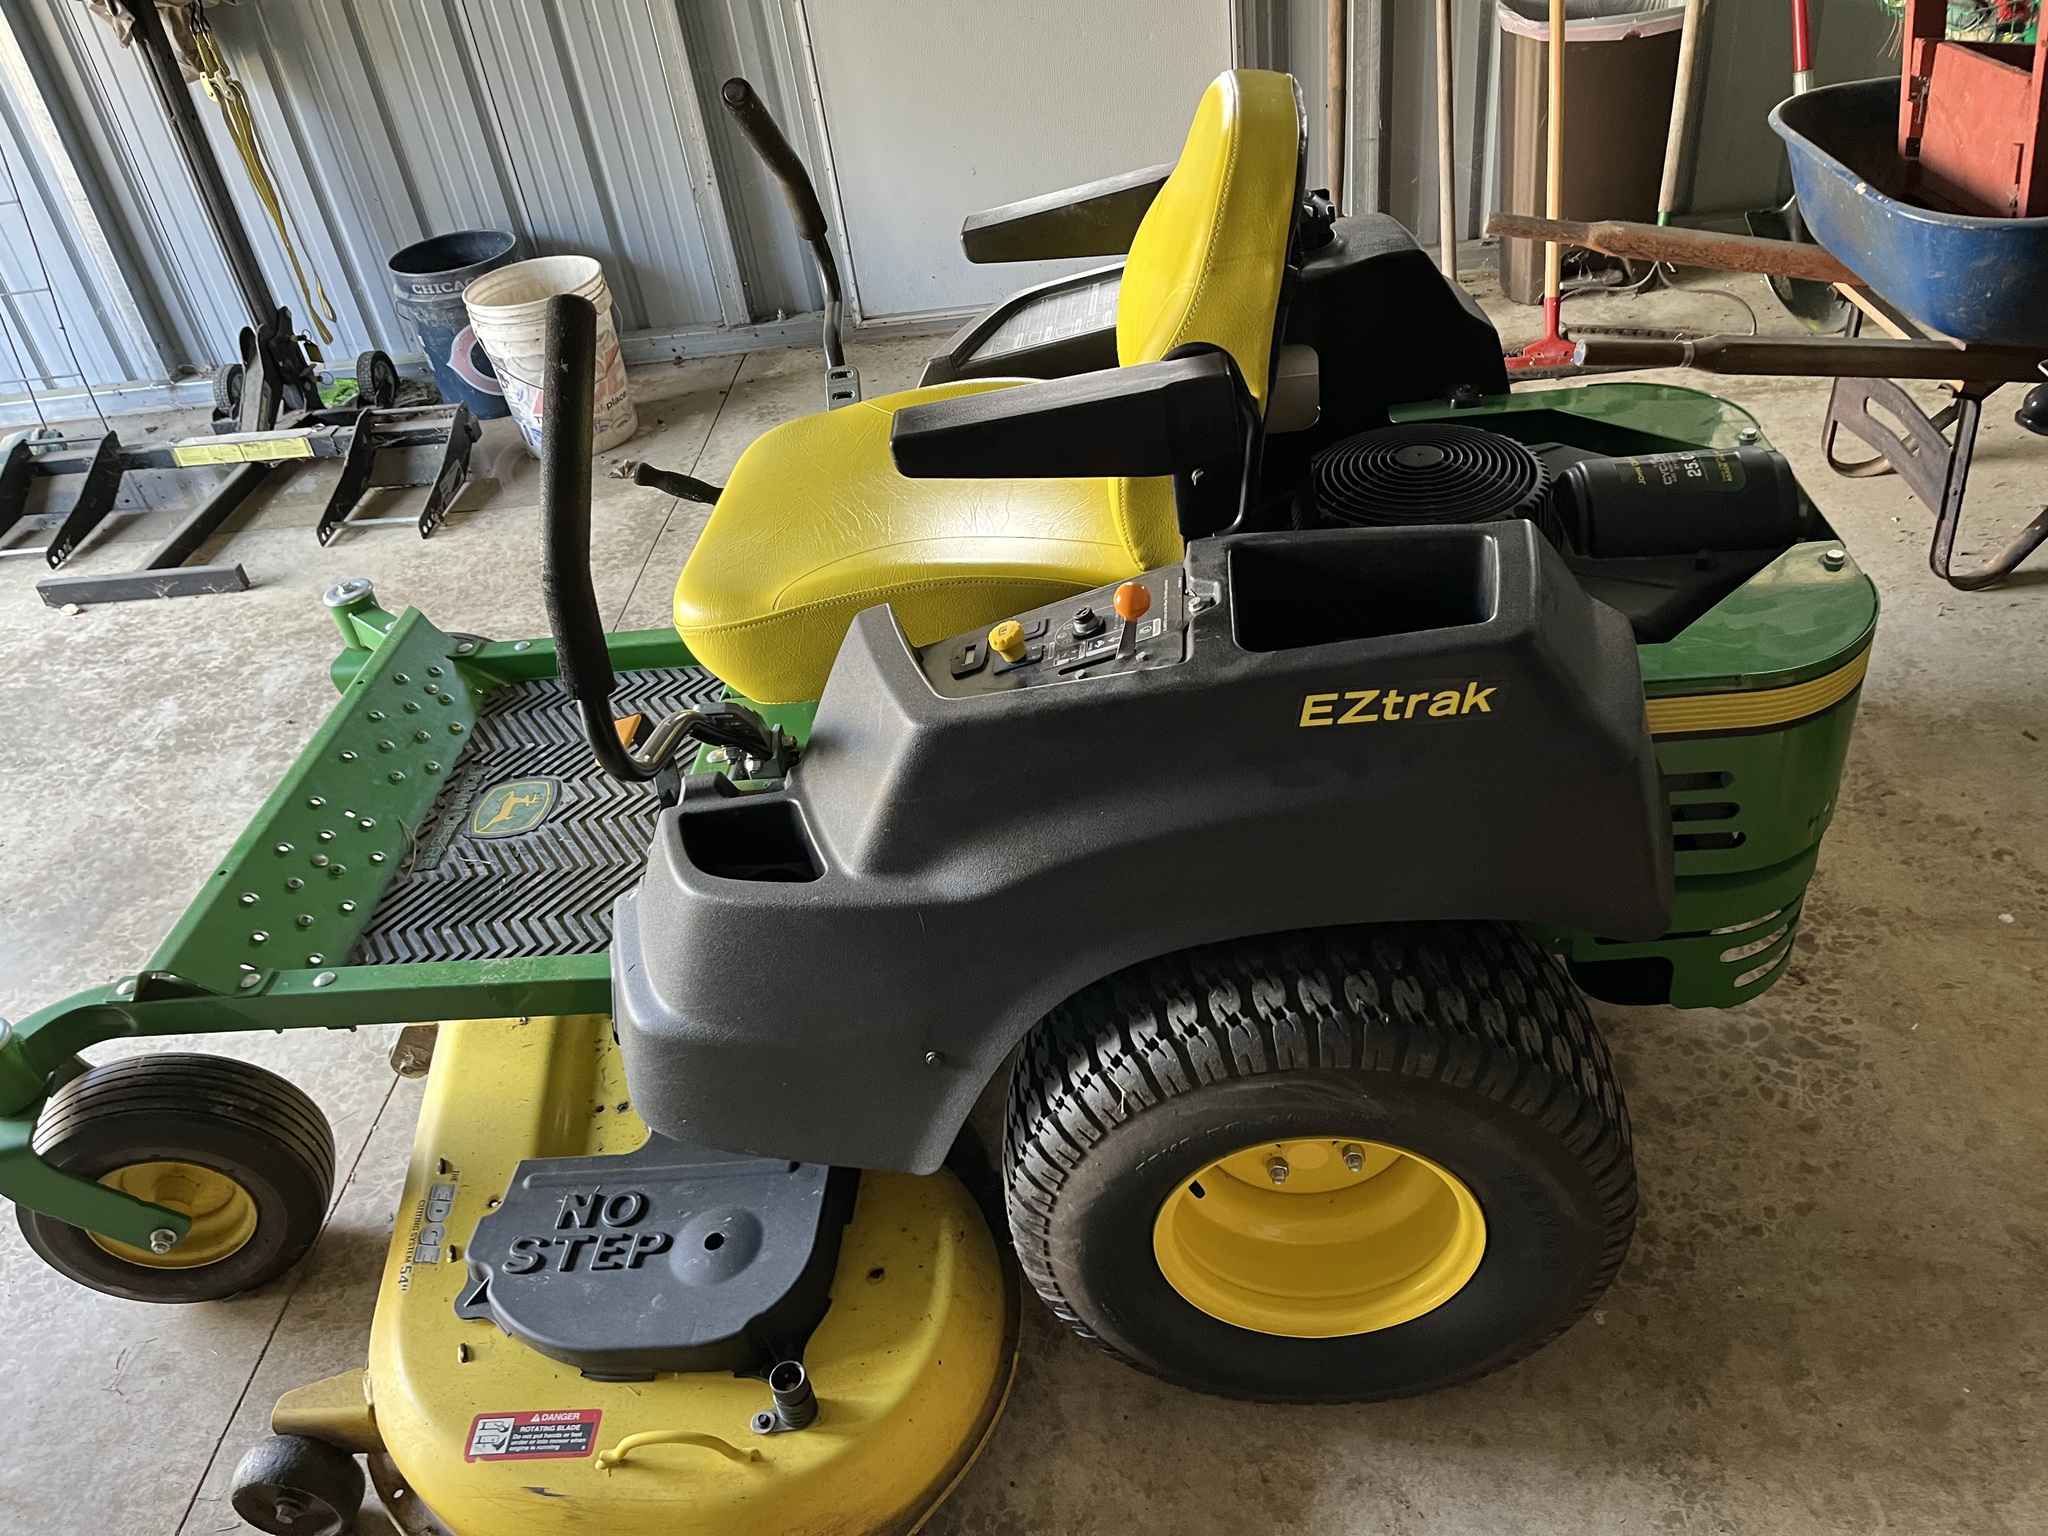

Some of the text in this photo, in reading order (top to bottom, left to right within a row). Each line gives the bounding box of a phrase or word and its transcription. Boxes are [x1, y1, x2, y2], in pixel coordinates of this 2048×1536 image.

[1300, 682, 1497, 727] EZtrak
[412, 1200, 426, 1231] CUTTING
[414, 1183, 456, 1264] EDGE
[555, 1189, 650, 1230] NO
[405, 1232, 418, 1263] SYSTEM
[501, 1231, 675, 1275] STEP
[541, 1412, 580, 1421] DANGER
